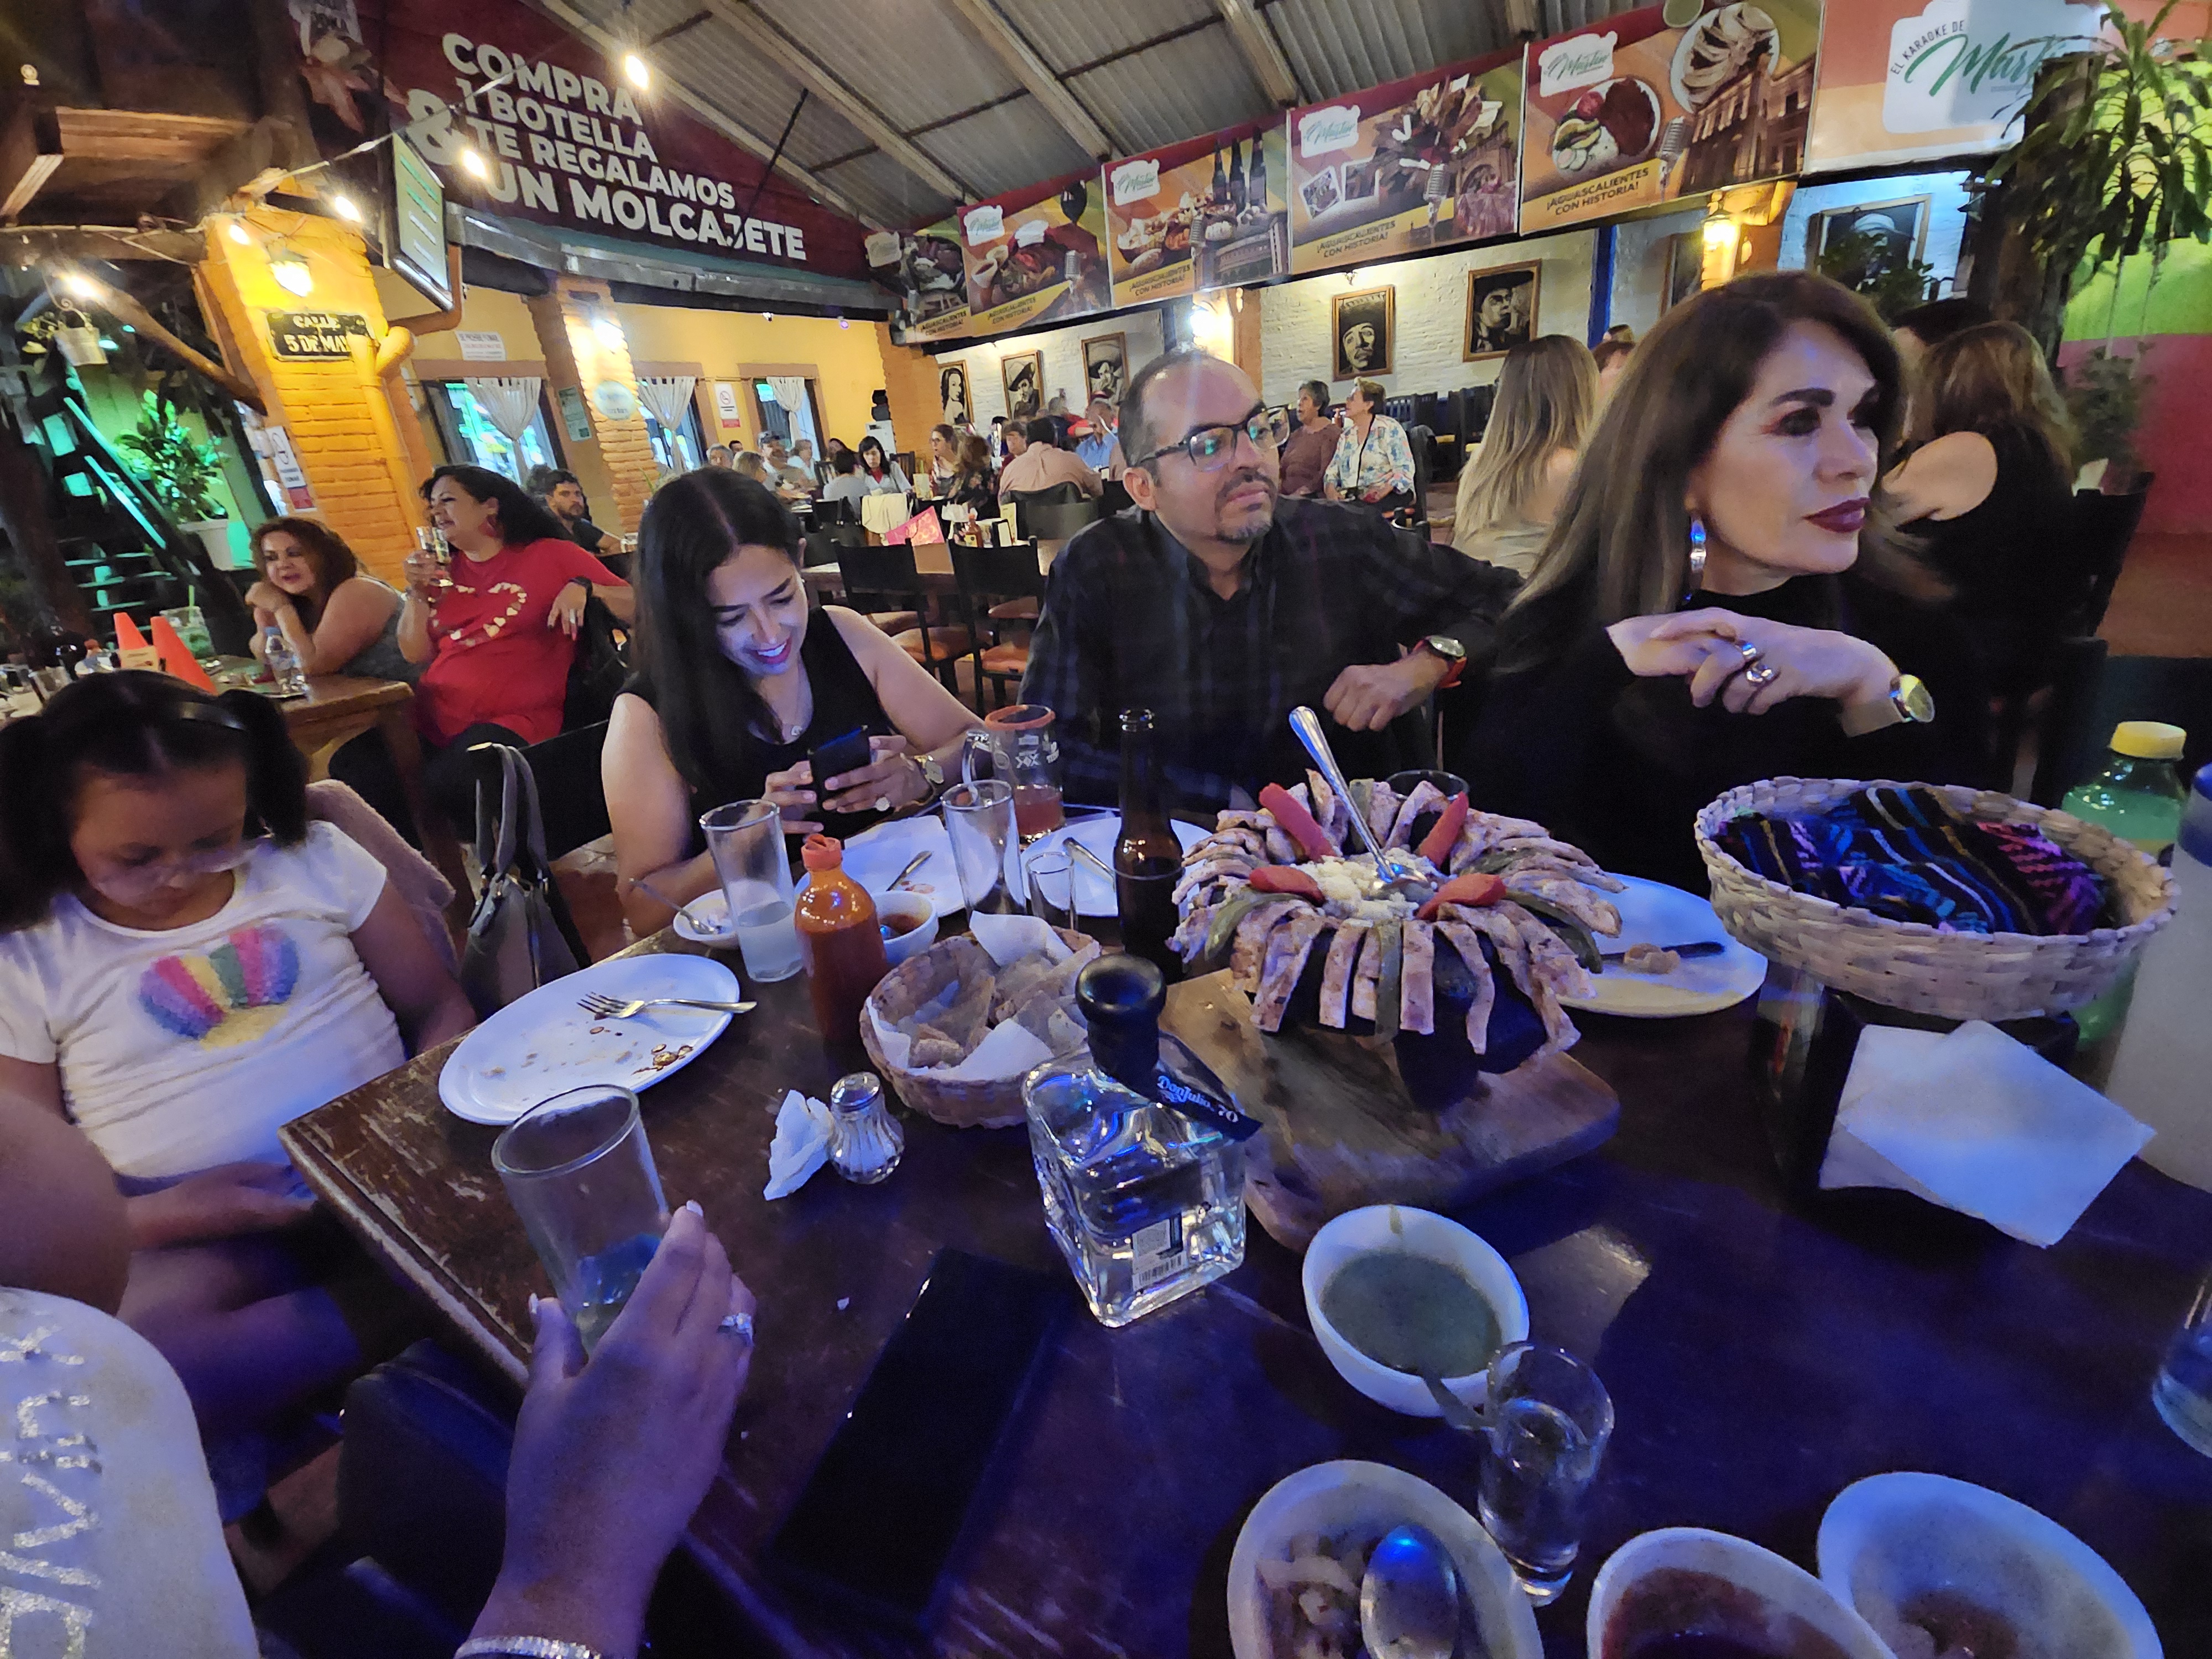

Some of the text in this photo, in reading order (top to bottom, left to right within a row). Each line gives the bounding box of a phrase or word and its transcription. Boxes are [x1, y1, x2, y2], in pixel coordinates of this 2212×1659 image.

[1890, 20, 1965, 75] EL KARAOKE DE
[443, 33, 642, 126] COMPRA
[456, 77, 659, 163] 1 BOTELLA
[406, 88, 470, 166] &
[466, 115, 522, 160] TE
[529, 133, 735, 210] REGALAMOS
[486, 161, 559, 213] UN
[568, 178, 807, 260] MOLCAJETE
[1547, 167, 1648, 211] ¡AGUASCALIENTES
[1556, 181, 1639, 215] CON HISTORIA!
[1324, 246, 1343, 257] CON
[1135, 285, 1150, 296] CON
[284, 334, 299, 352] 5
[293, 315, 341, 329] CALLE
